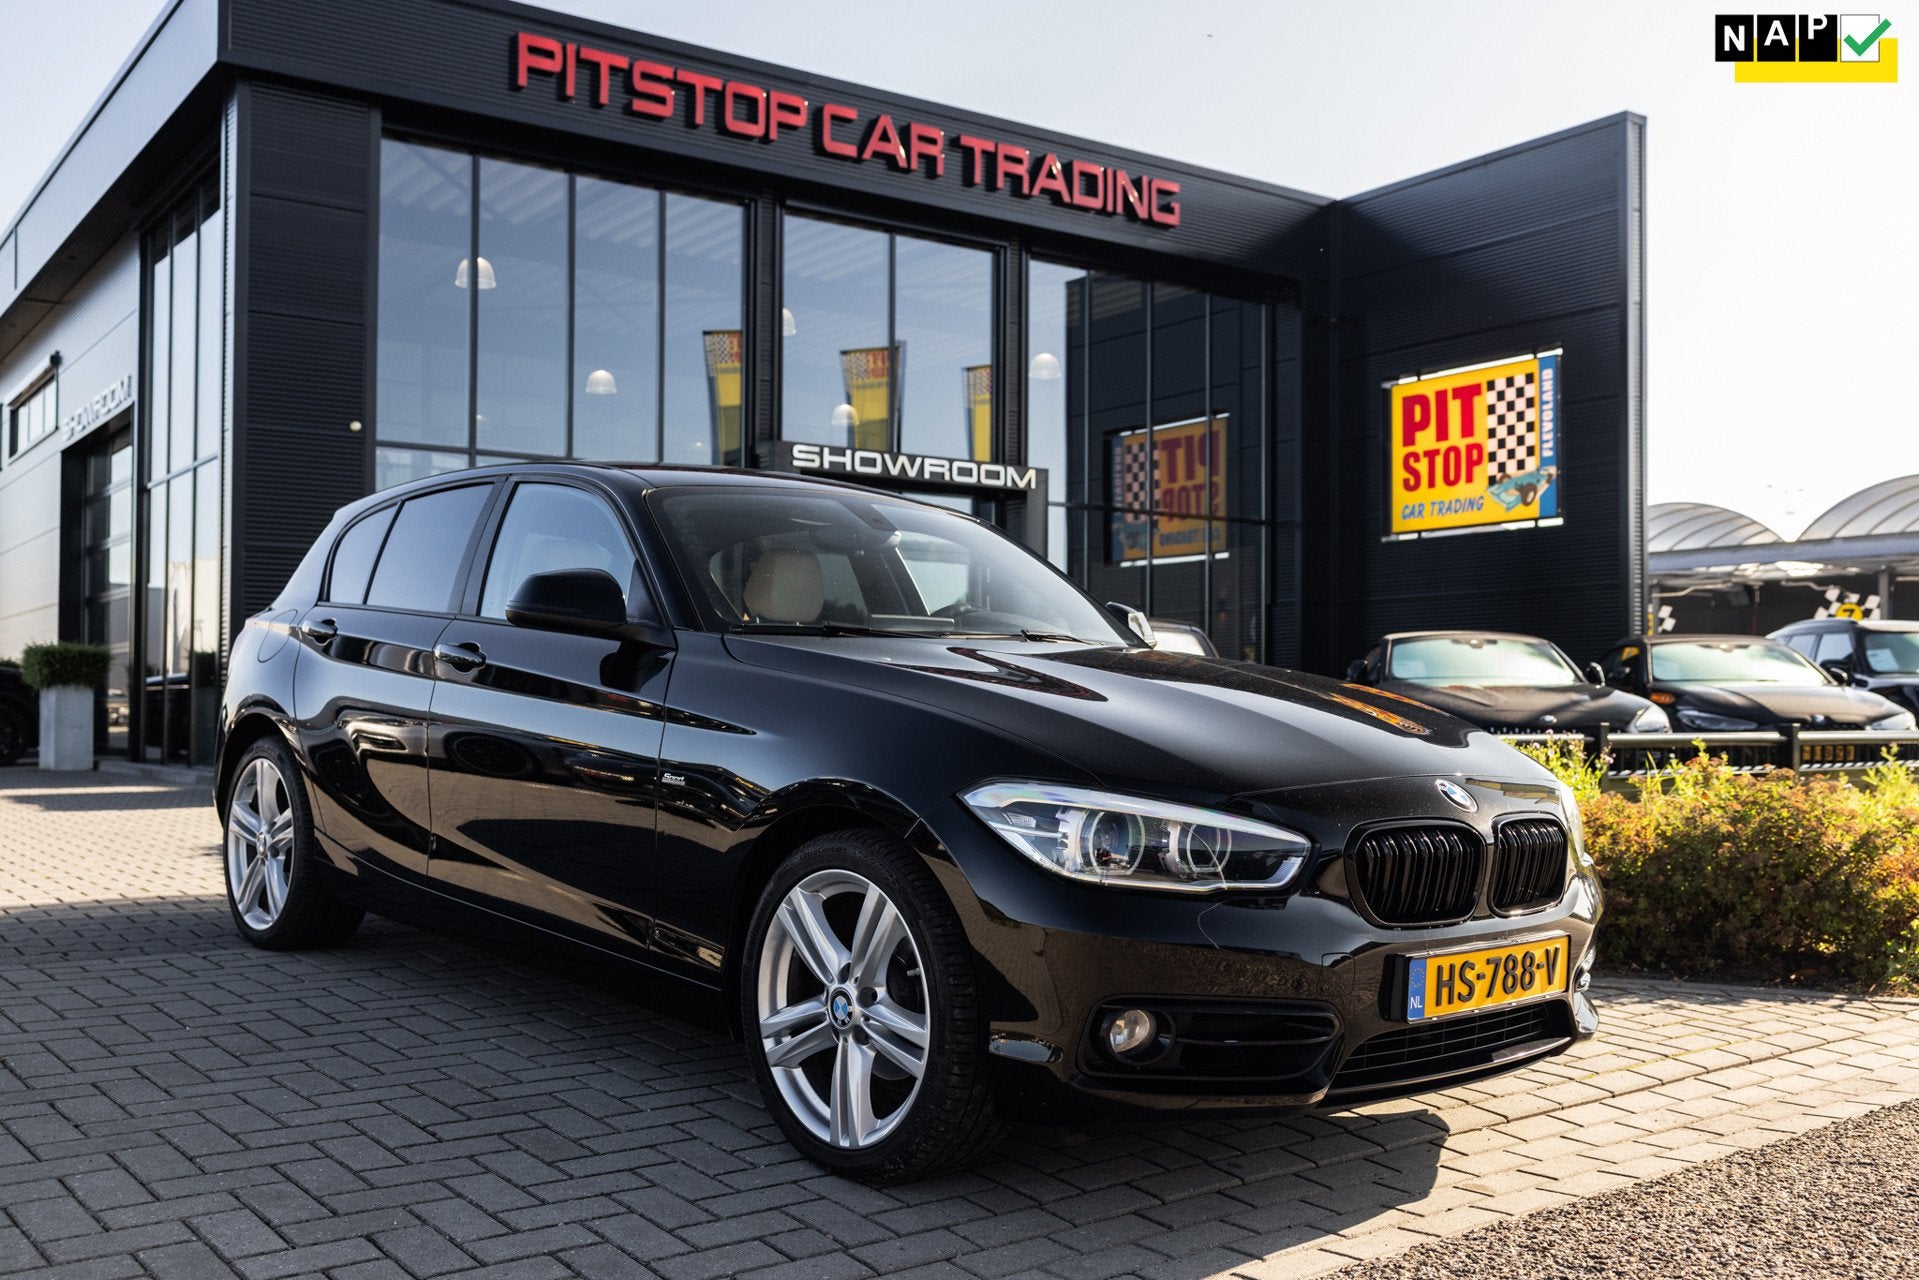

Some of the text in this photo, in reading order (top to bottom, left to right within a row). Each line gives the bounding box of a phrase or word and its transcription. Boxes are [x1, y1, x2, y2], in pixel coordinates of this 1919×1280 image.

[516, 31, 1181, 227] PITSTOP CAR TRADING
[1402, 383, 1482, 447] PIT
[1541, 368, 1554, 458] FLEVOLAND
[792, 444, 1037, 489] SHOWROOM
[1402, 442, 1484, 492] STOP
[1402, 496, 1485, 520] CAR TRADING
[1409, 996, 1423, 1010] NL
[1435, 946, 1561, 1006] HS-788-V
